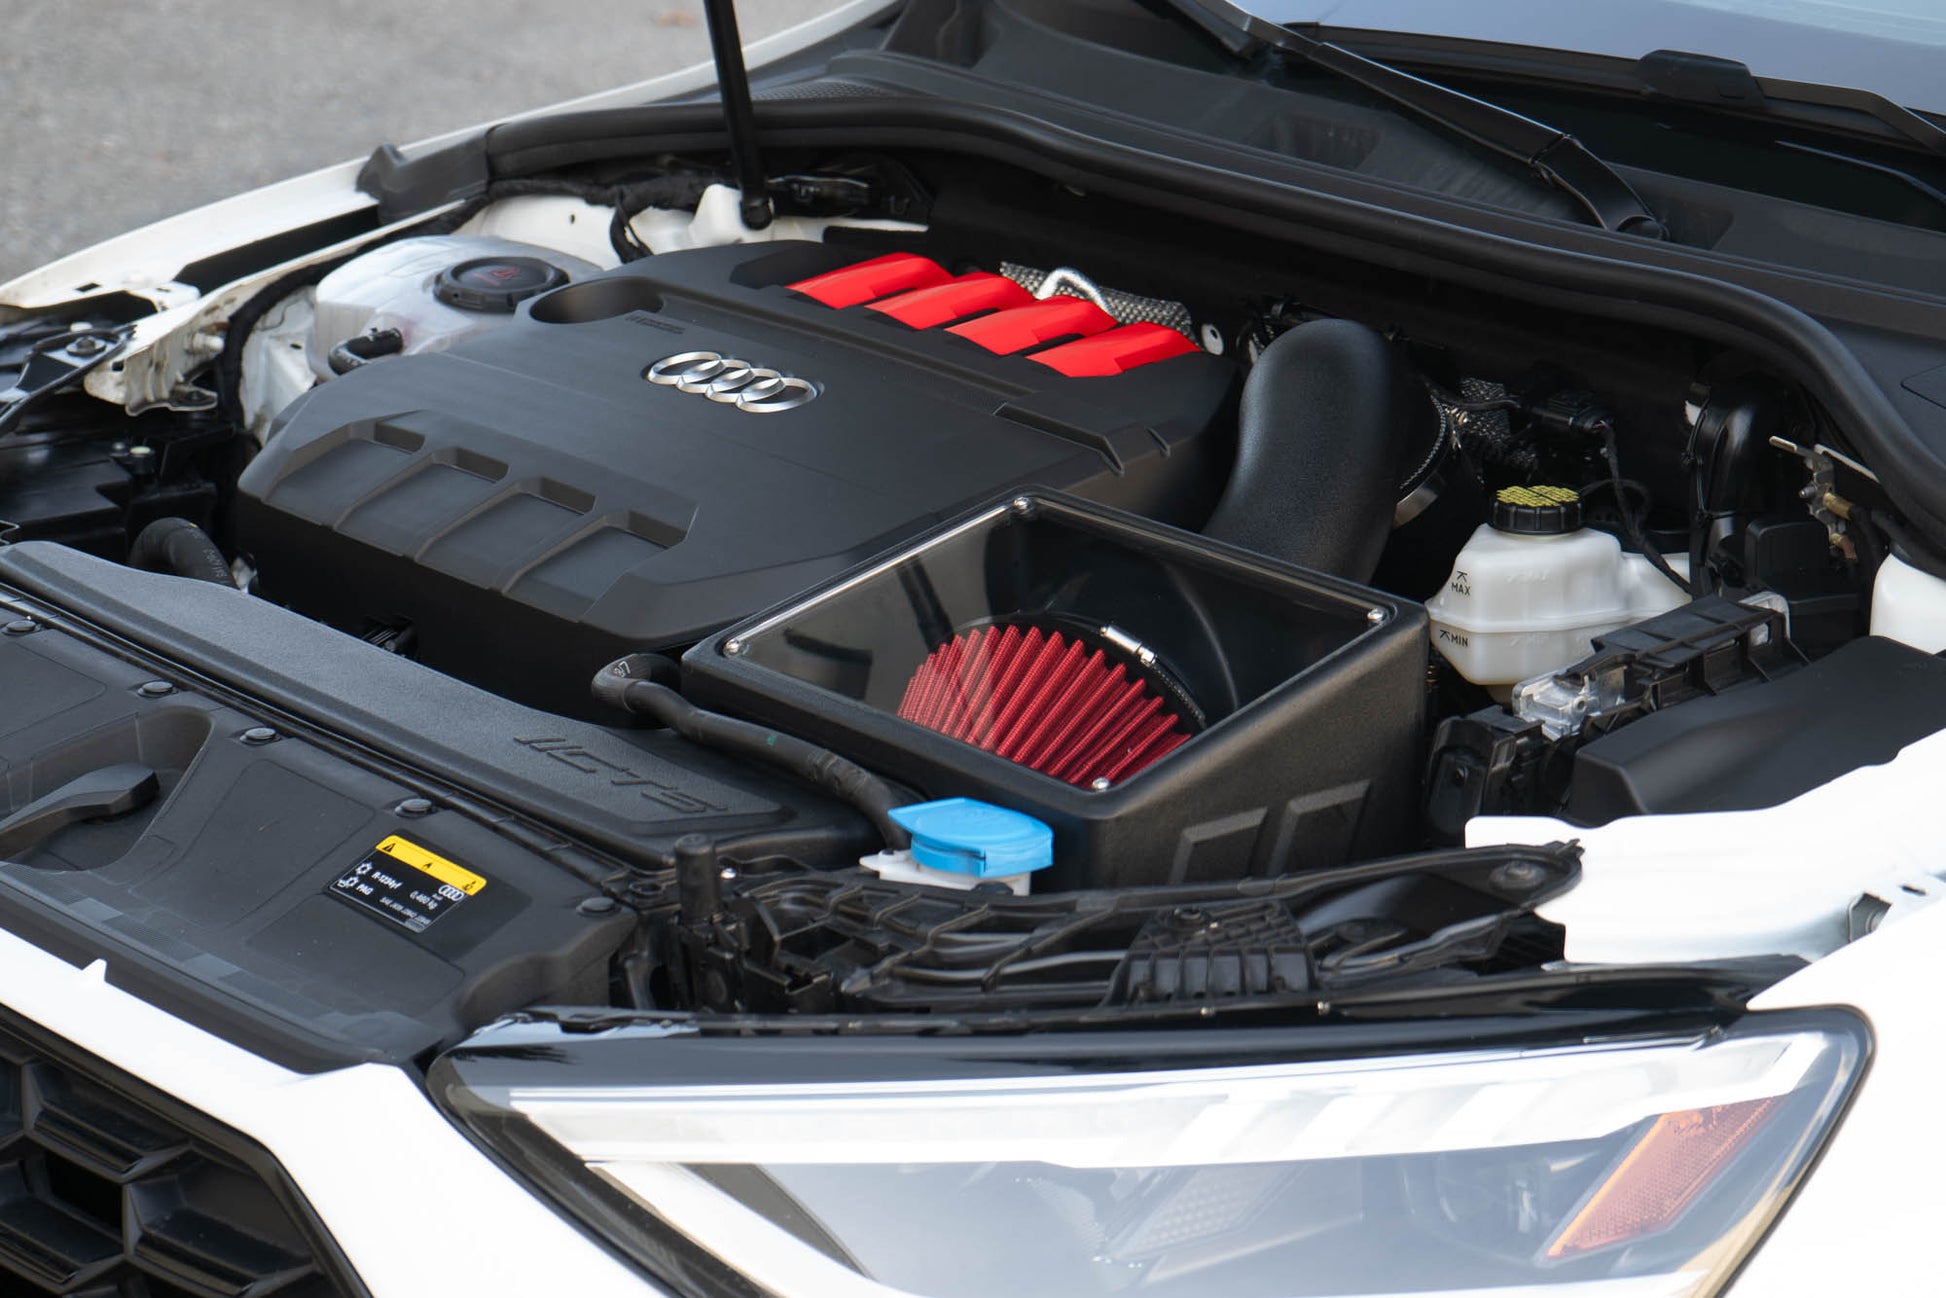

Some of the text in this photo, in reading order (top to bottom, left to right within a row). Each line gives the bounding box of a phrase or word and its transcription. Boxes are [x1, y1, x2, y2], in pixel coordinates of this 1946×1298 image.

[1451, 581, 1471, 596] MAX
[1451, 633, 1469, 647] MIN
[356, 883, 374, 896] PAG
